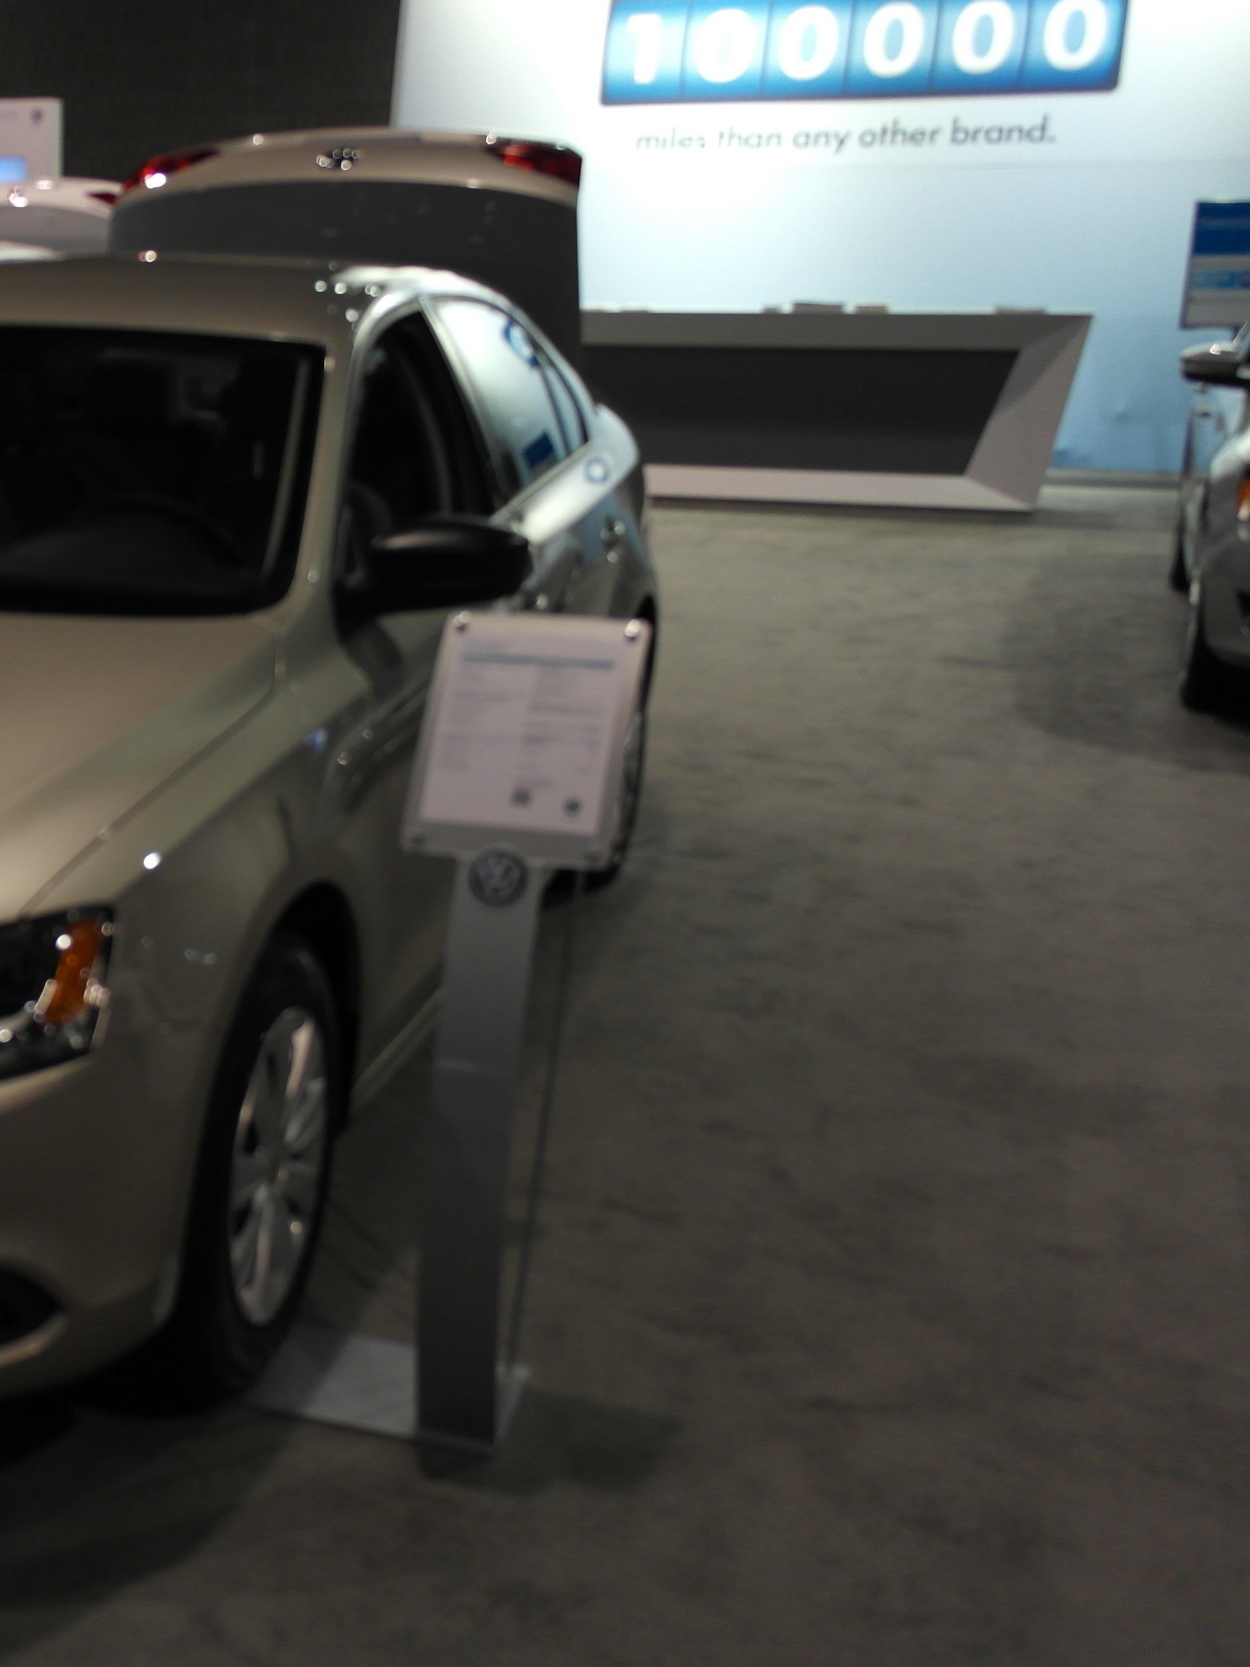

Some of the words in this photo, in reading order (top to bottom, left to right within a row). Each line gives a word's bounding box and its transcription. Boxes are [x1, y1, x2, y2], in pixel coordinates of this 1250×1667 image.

[626, 0, 1108, 85] 100000
[635, 126, 706, 150] miles
[717, 124, 783, 150] than
[792, 127, 850, 154] any
[858, 117, 942, 149] other
[950, 112, 1056, 146] brand.
